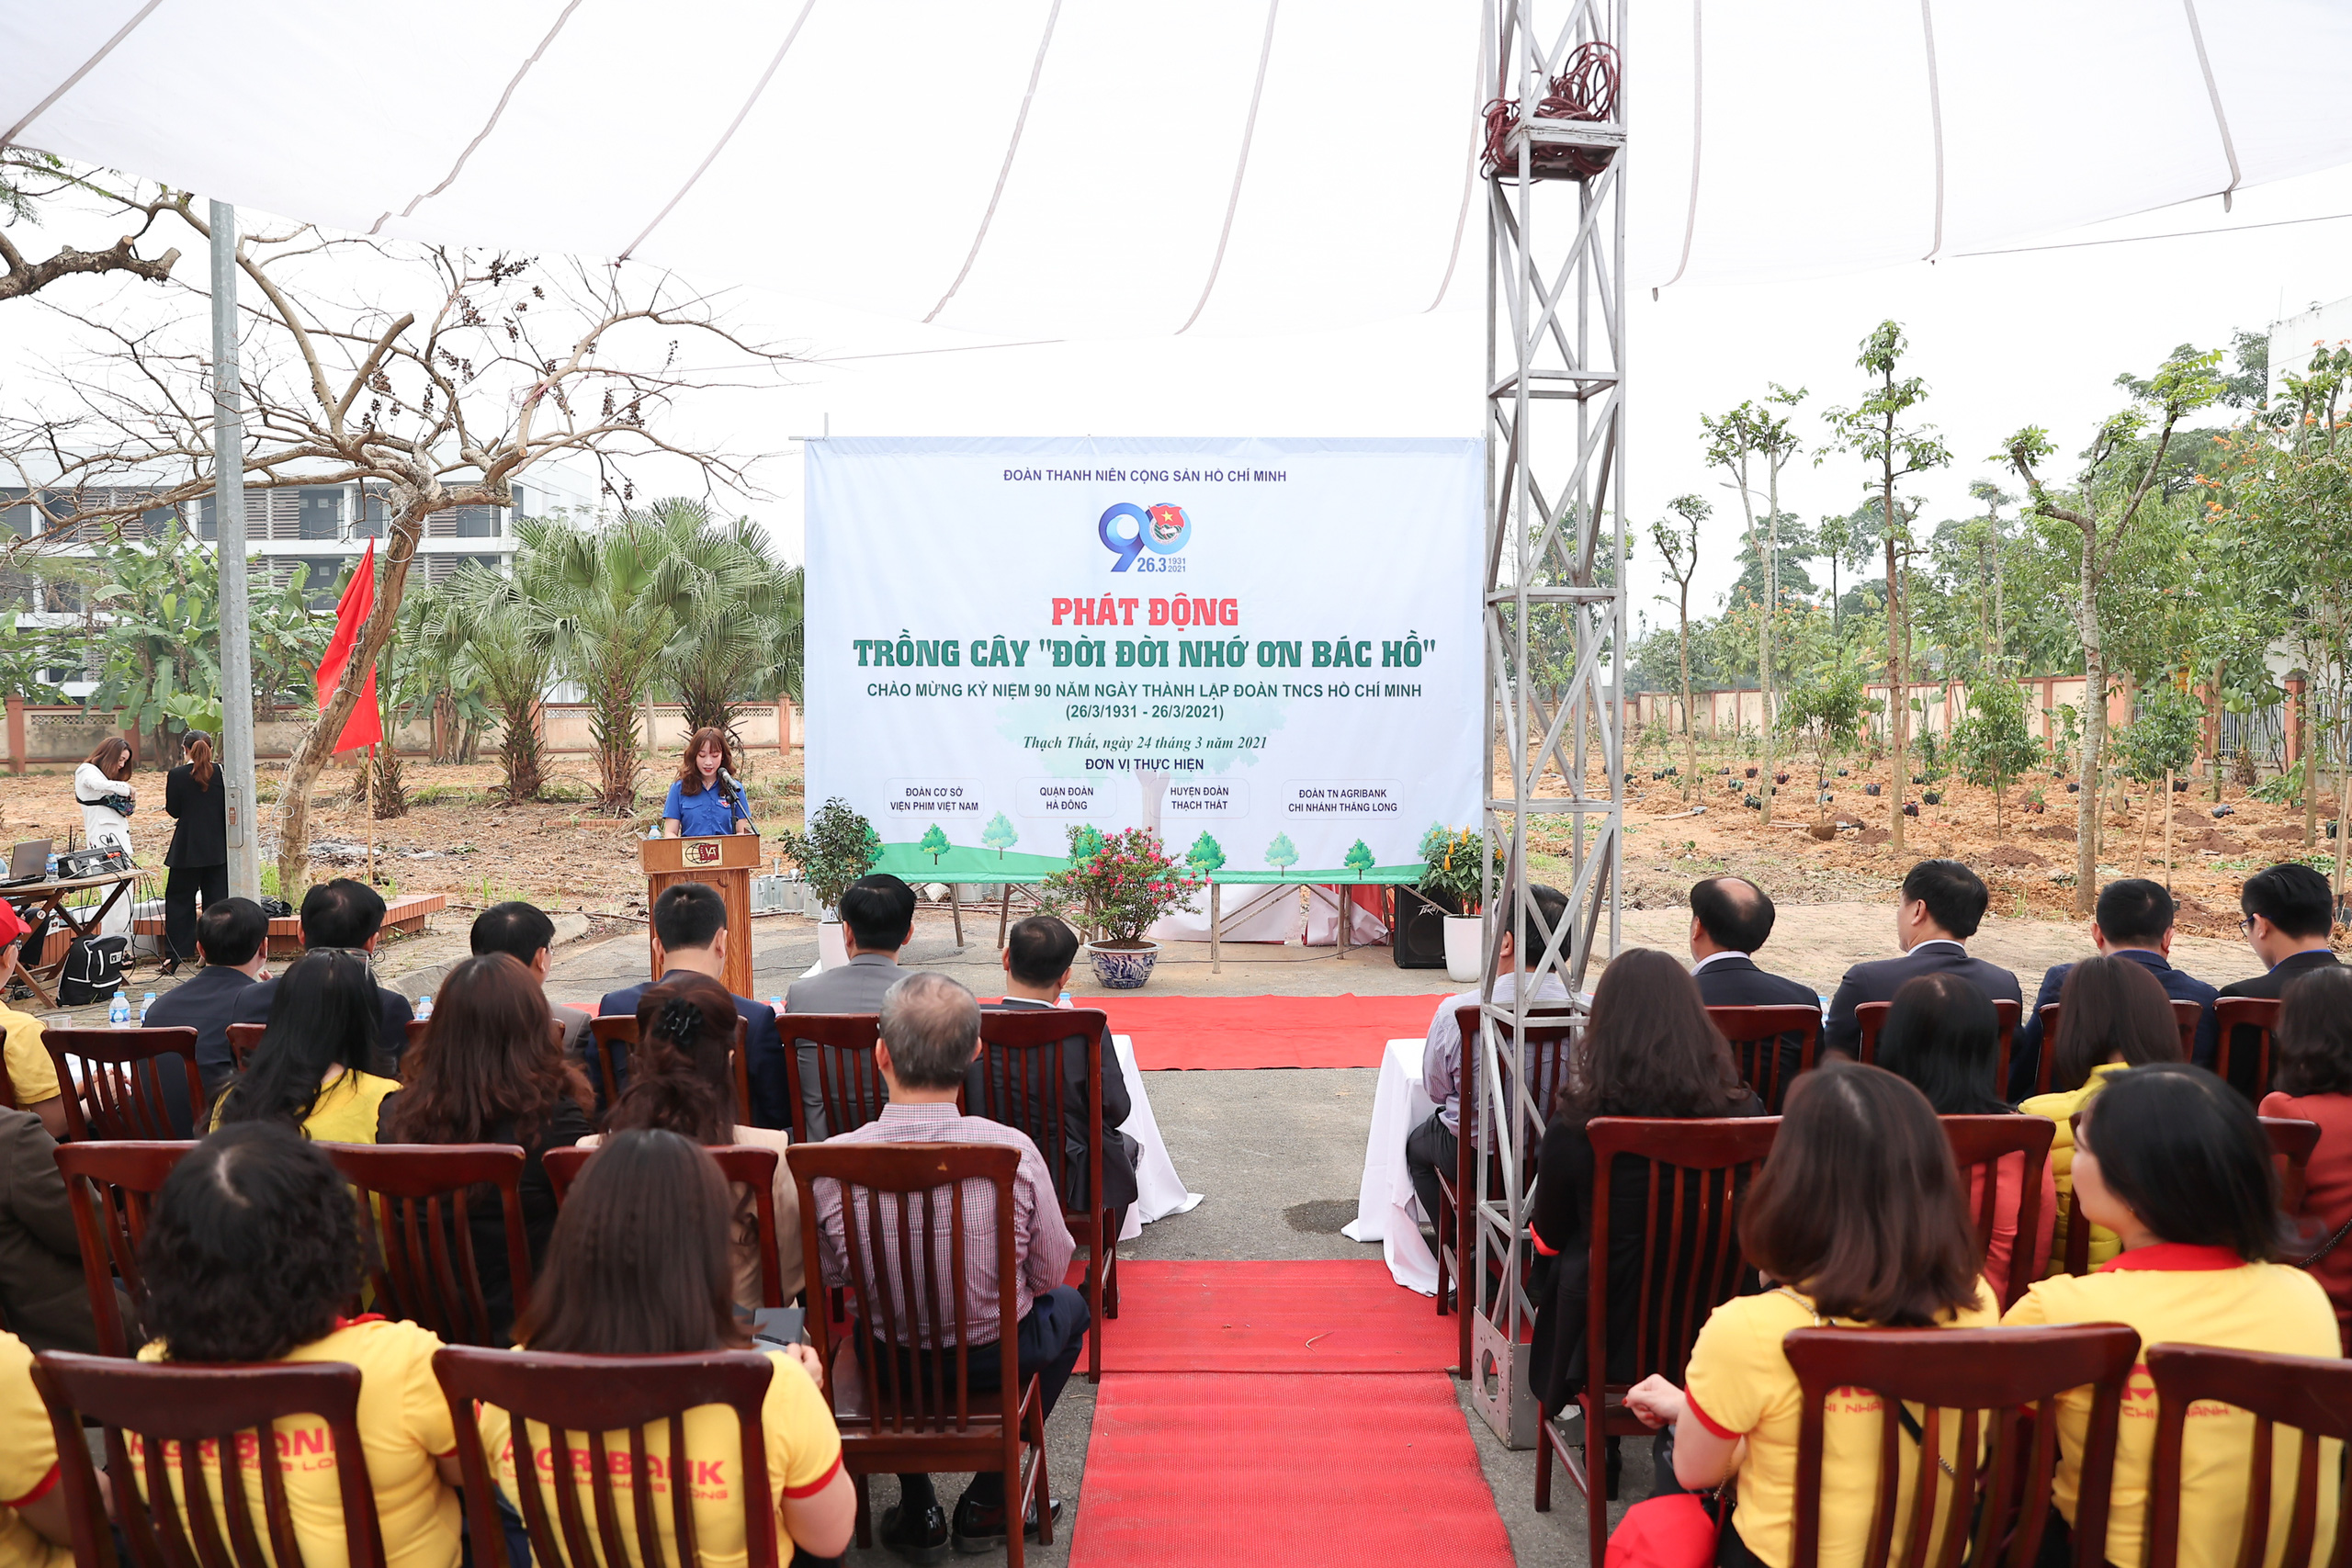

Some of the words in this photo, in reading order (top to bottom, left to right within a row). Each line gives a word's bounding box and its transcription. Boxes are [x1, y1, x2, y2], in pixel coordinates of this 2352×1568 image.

[1002, 467, 1042, 481] ĐOÀN
[1046, 469, 1091, 481] THANH
[1095, 467, 1126, 482] NIÊN
[1129, 468, 1170, 486] CỘNG
[1227, 467, 1250, 482] CHÍ
[1253, 469, 1287, 482] MINH
[1136, 557, 1167, 572] 26.3
[1168, 557, 1186, 565] 1931
[1168, 565, 1186, 573] 2021
[1051, 592, 1139, 626] PHÁT
[1148, 592, 1239, 632] ĐỘNG
[853, 627, 961, 668] TRỒNG
[970, 634, 1031, 668] CÂY
[1114, 634, 1170, 668] ĐỜI
[1177, 634, 1250, 668] NHỚ
[1256, 640, 1303, 668] ƠN
[1311, 635, 1373, 668] BÁC
[866, 680, 911, 697] CHÀO
[915, 680, 963, 697] MỪNG
[967, 680, 989, 697] KỶ
[992, 682, 1030, 701] NIỆM
[1034, 683, 1052, 698] 90
[1056, 681, 1091, 698] NĂM
[1094, 680, 1138, 698] NGÀY
[1142, 680, 1195, 698] THÀNH
[1199, 682, 1230, 702] LẬP
[1232, 681, 1278, 698] ĐOÀN
[1282, 683, 1324, 698] TNCS
[1354, 681, 1381, 698] CHÍ
[1384, 683, 1422, 698] MINH
[1065, 704, 1137, 722] (26/3/1931
[1151, 704, 1225, 722] 26/3/2021)
[1023, 735, 1063, 752] Thạch
[1067, 732, 1099, 752] Thất,
[1102, 736, 1134, 752] ngày
[1136, 736, 1152, 750] 24
[1154, 736, 1193, 752] tháng
[1194, 736, 1204, 750] 3
[1205, 736, 1234, 750] năm
[1237, 736, 1268, 750] 2021
[1084, 758, 1114, 771] ĐƠN
[1117, 758, 1130, 773] VỊ
[1133, 758, 1170, 773] THỰC
[1173, 757, 1204, 773] HIỆN
[905, 785, 932, 797] ĐOÀN
[933, 787, 948, 797] CƠ
[1068, 784, 1094, 796] ĐOÀN
[1203, 784, 1229, 796] ĐOÀN
[1298, 787, 1325, 798] ĐOÀN
[1327, 788, 1340, 798] TN
[1340, 788, 1387, 798] AGRIBANK
[889, 801, 911, 813] VIỆN
[912, 801, 935, 811] PHIM
[936, 801, 957, 813] VIỆT
[958, 801, 979, 811] NAM
[1046, 799, 1059, 810] HÀ
[1060, 799, 1088, 810] ĐÔNG
[1170, 800, 1203, 812] THẠCH
[1288, 803, 1304, 812] CHI
[1306, 802, 1338, 812] NHÁNH
[1339, 801, 1371, 812] THĂNG
[1372, 802, 1398, 812] LONG
